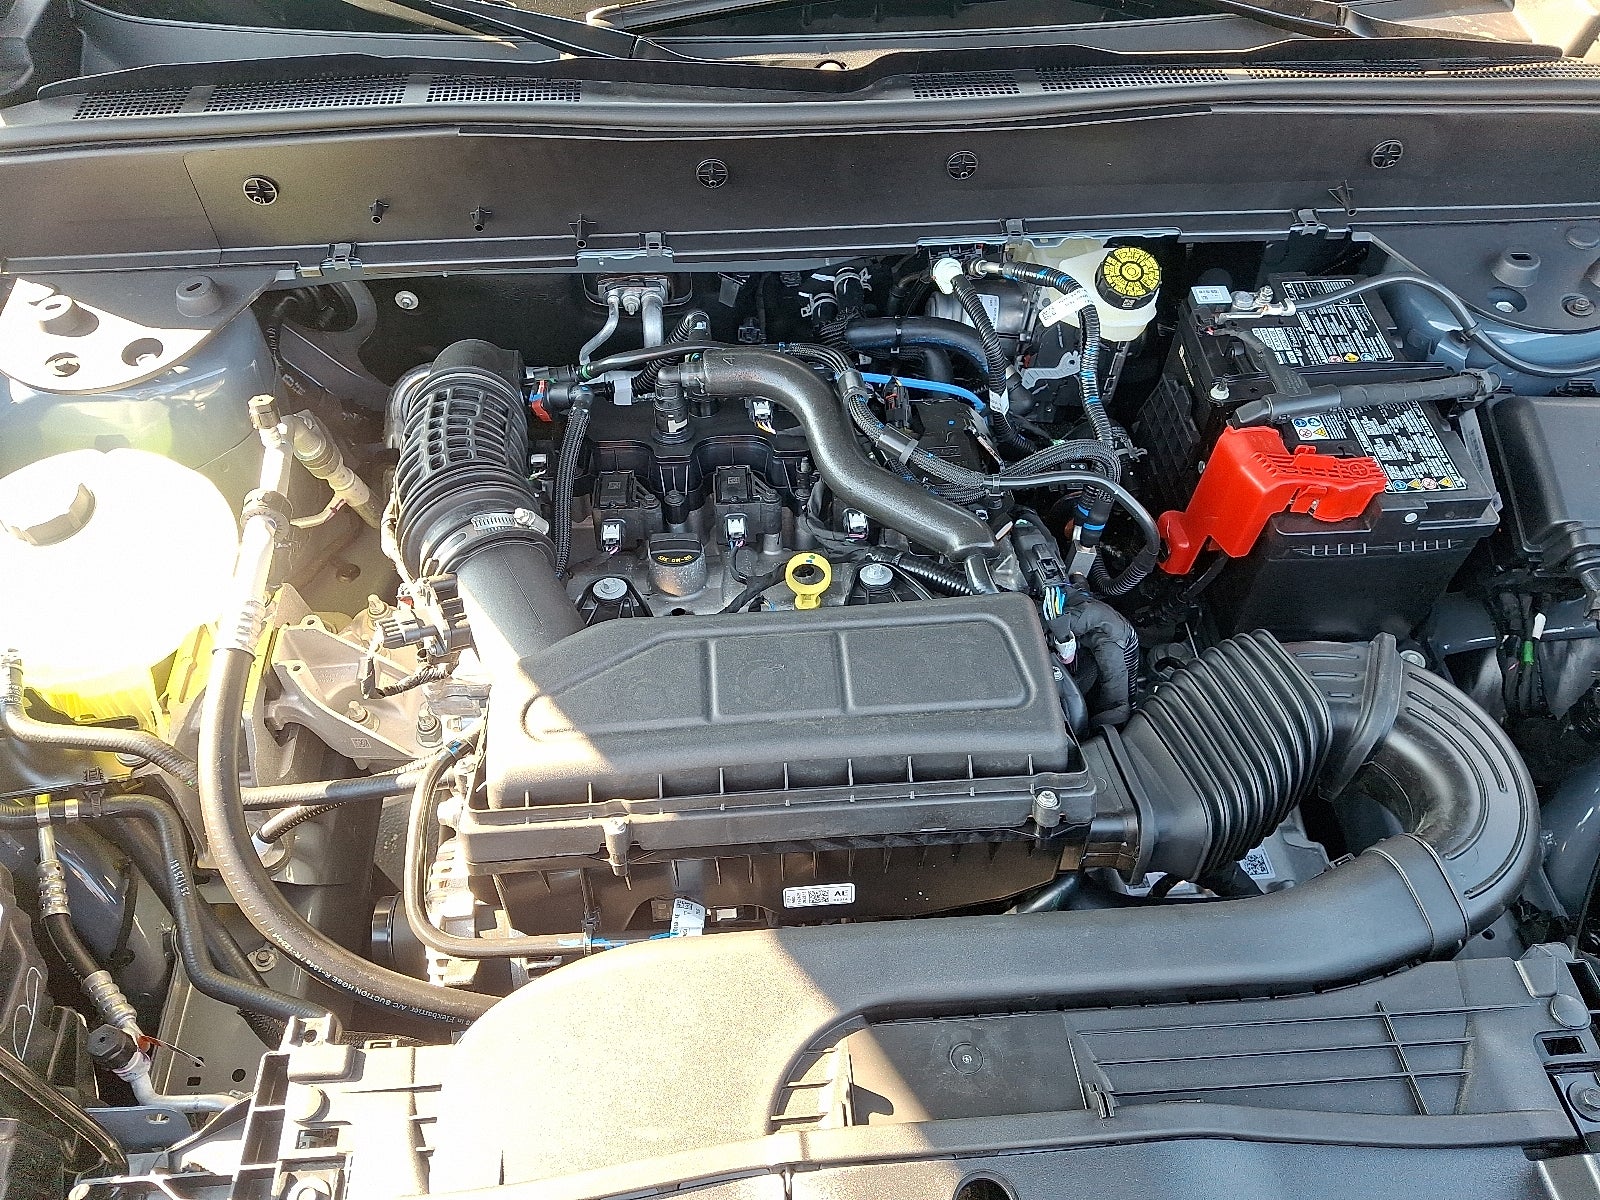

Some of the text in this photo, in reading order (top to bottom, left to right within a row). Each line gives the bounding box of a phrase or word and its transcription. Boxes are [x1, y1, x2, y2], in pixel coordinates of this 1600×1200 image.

[331, 975, 354, 991] HOSE
[354, 986, 392, 1006] SUCTION
[392, 1002, 408, 1011] A/C
